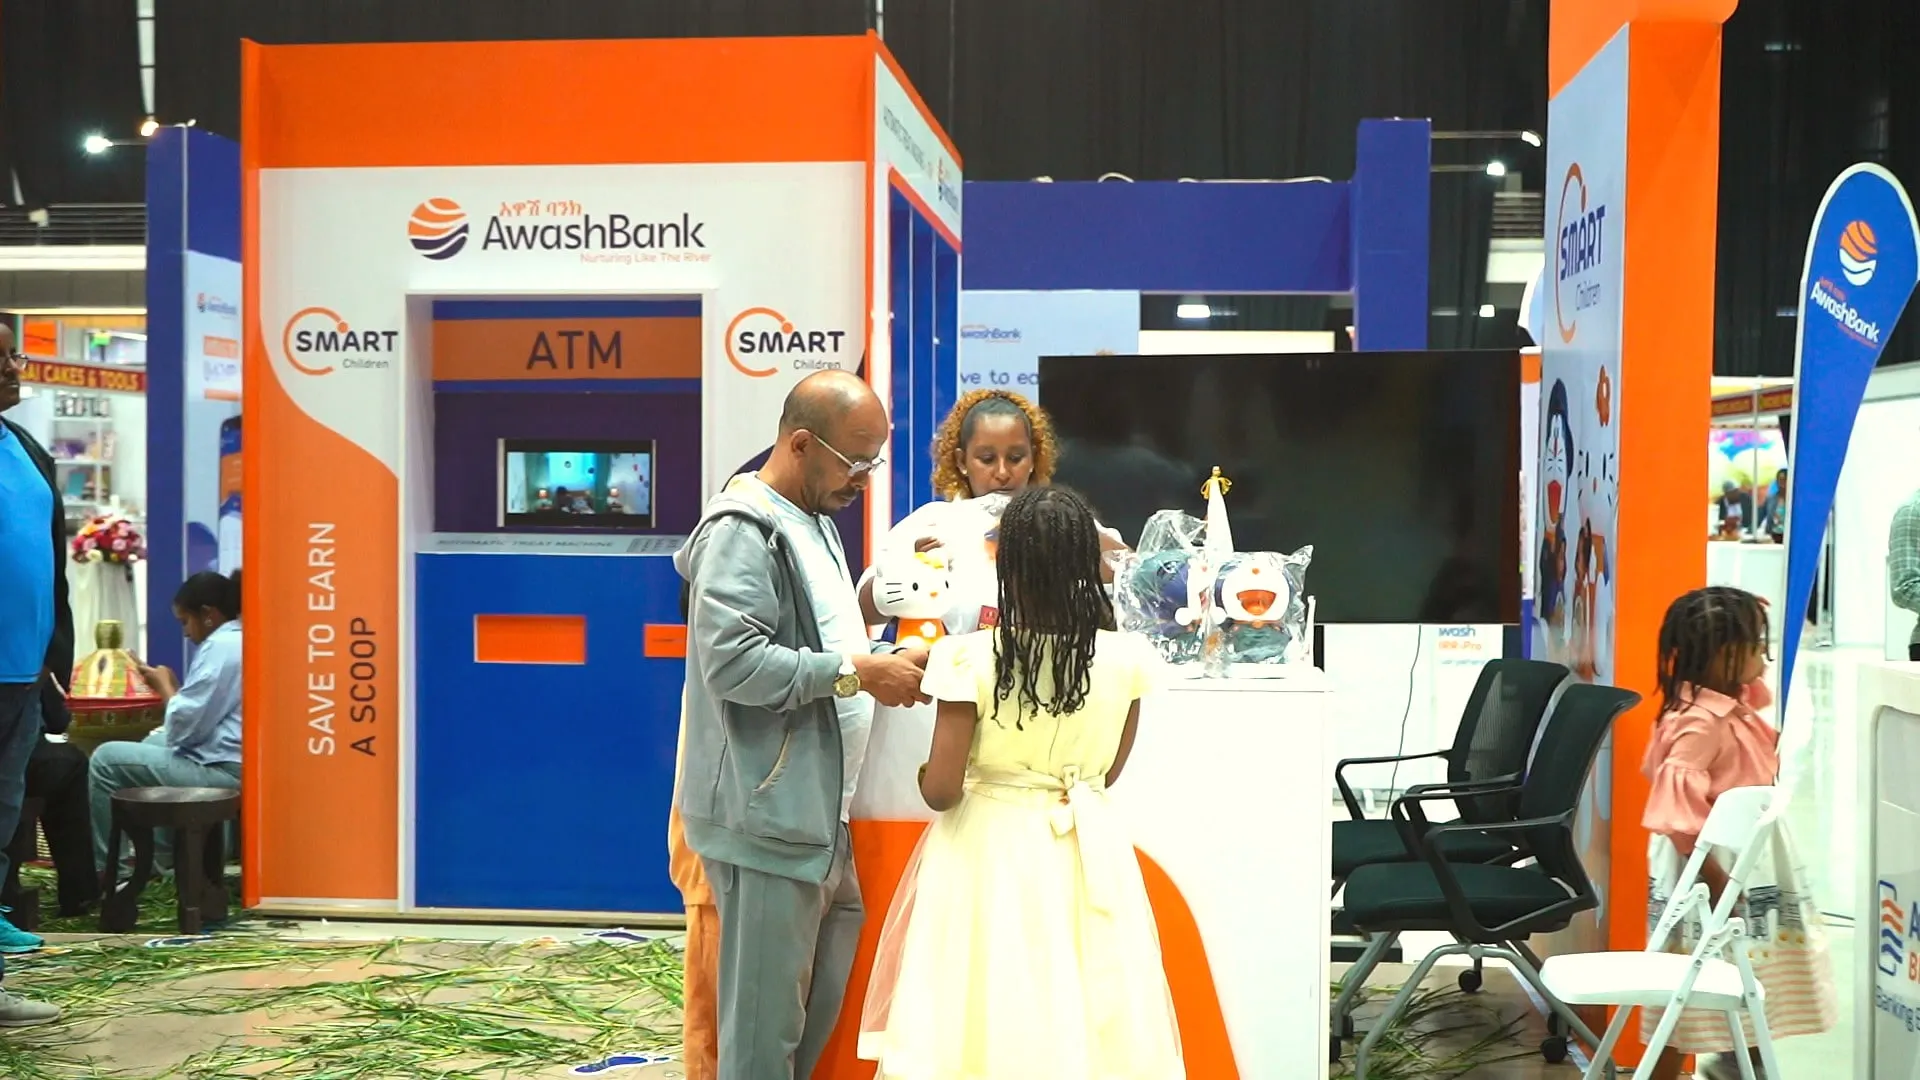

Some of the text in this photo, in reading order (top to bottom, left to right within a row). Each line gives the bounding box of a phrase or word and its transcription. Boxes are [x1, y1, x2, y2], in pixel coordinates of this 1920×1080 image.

[482, 212, 705, 251] AwashBank
[1560, 204, 1606, 281] SMART
[580, 252, 711, 265] Nurturing Like The River
[1810, 281, 1880, 343] AwashBank
[296, 330, 399, 352] SMART
[739, 331, 845, 353] SMART
[961, 328, 1022, 341] washBank
[526, 330, 622, 370] ATM
[342, 358, 390, 369] Children
[793, 359, 841, 370] Children
[960, 372, 981, 385] ve
[989, 369, 1010, 385] to
[308, 523, 336, 756] SAVE TO EARN
[350, 617, 376, 757] A SCOOP
